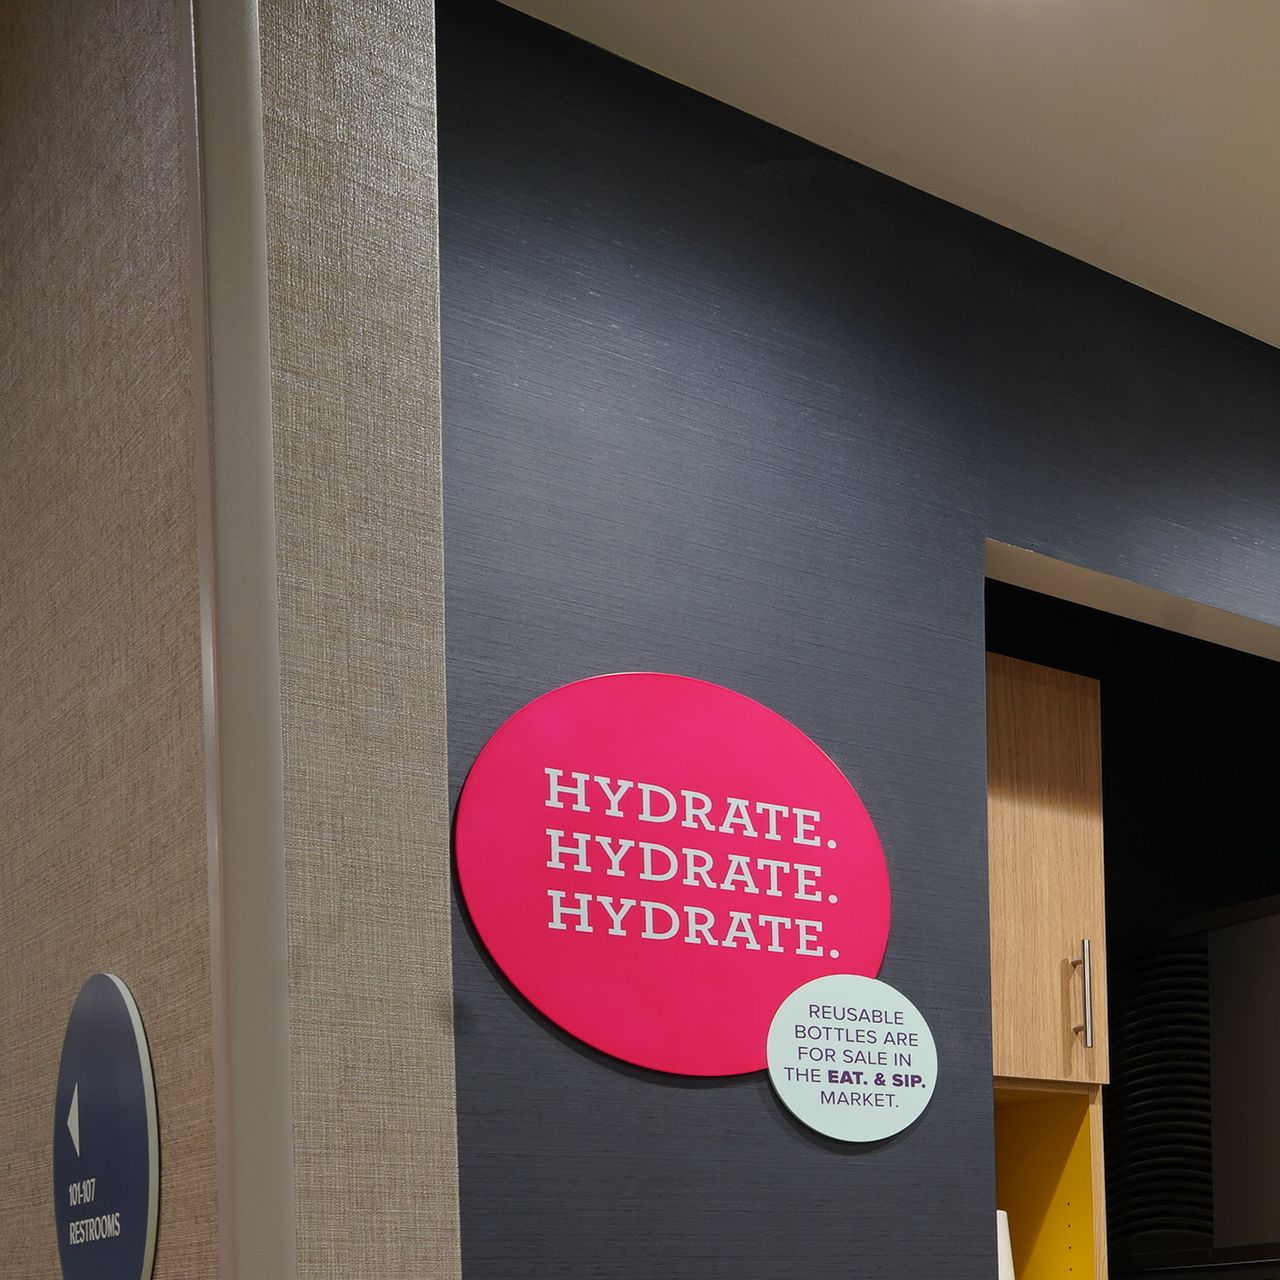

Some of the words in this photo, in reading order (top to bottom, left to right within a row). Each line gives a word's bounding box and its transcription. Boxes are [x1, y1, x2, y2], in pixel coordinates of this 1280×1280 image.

[544, 767, 838, 850] HYDRATE.
[545, 828, 839, 905] HYDRATE.
[546, 889, 840, 959] HYDRATE.
[809, 1004, 904, 1025] REUSABLE
[795, 1024, 878, 1044] BOTTLES
[883, 1032, 919, 1047] ARE
[798, 1046, 836, 1063] FOR
[842, 1050, 888, 1066] SALE
[894, 1053, 912, 1067] IN
[784, 1066, 821, 1083] THE
[828, 1069, 868, 1086] EAT.
[873, 1072, 887, 1087] &
[892, 1074, 926, 1089] SIP.
[820, 1090, 899, 1108] MARKET.
[69, 1178, 96, 1207] 101-107
[70, 1212, 121, 1245] RESTROOMS
